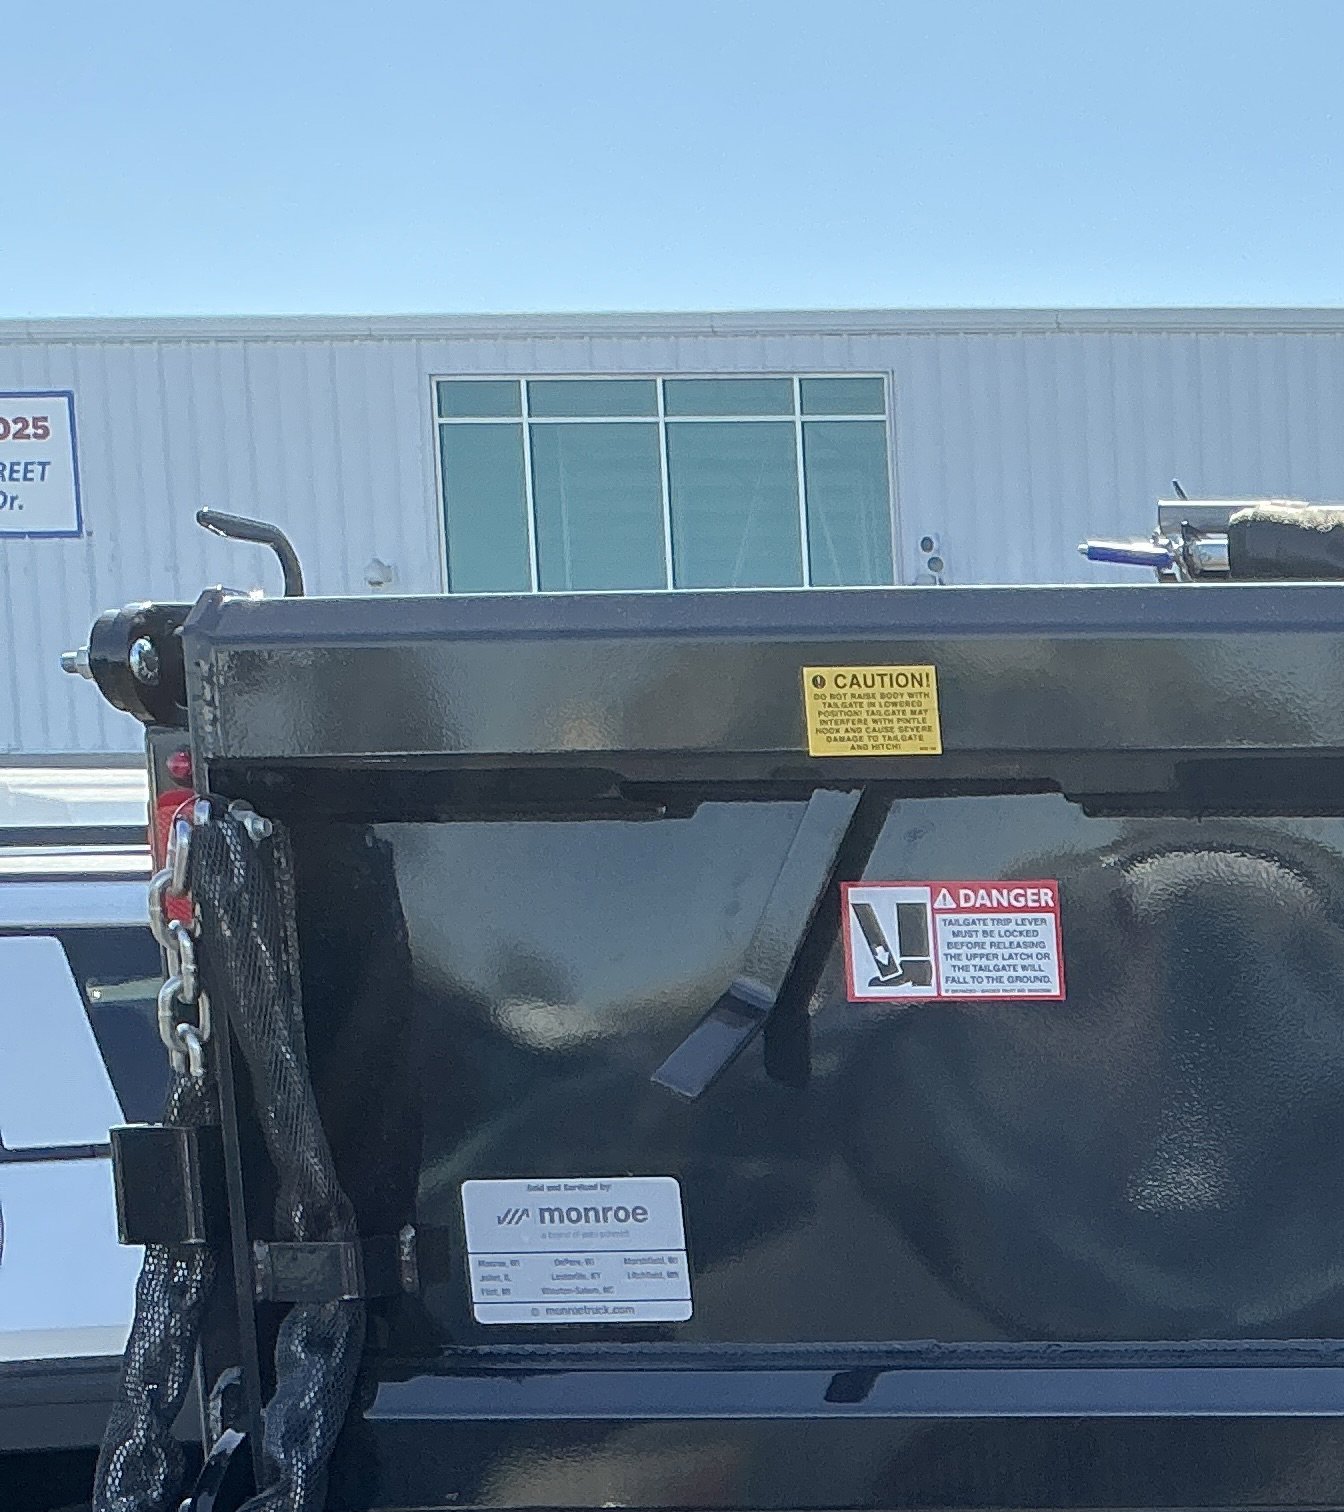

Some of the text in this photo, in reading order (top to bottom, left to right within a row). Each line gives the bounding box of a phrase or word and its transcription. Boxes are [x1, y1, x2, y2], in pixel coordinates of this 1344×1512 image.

[834, 672, 930, 689] CAUTION!
[959, 888, 1054, 908] DANGER
[942, 918, 1047, 927] TAILGATE TRIP LEVER
[952, 930, 1039, 938] MUST BE LOCKED
[947, 941, 1046, 950] BEFORE RELEASING
[944, 953, 962, 961] THE
[966, 953, 999, 961] UPPER
[1036, 952, 1050, 960] OR
[951, 964, 1044, 972] THE TAILGATE WILL
[945, 976, 970, 984] FALL
[970, 976, 984, 984] TO
[985, 976, 1005, 984] THE
[539, 1205, 648, 1225] monroe
